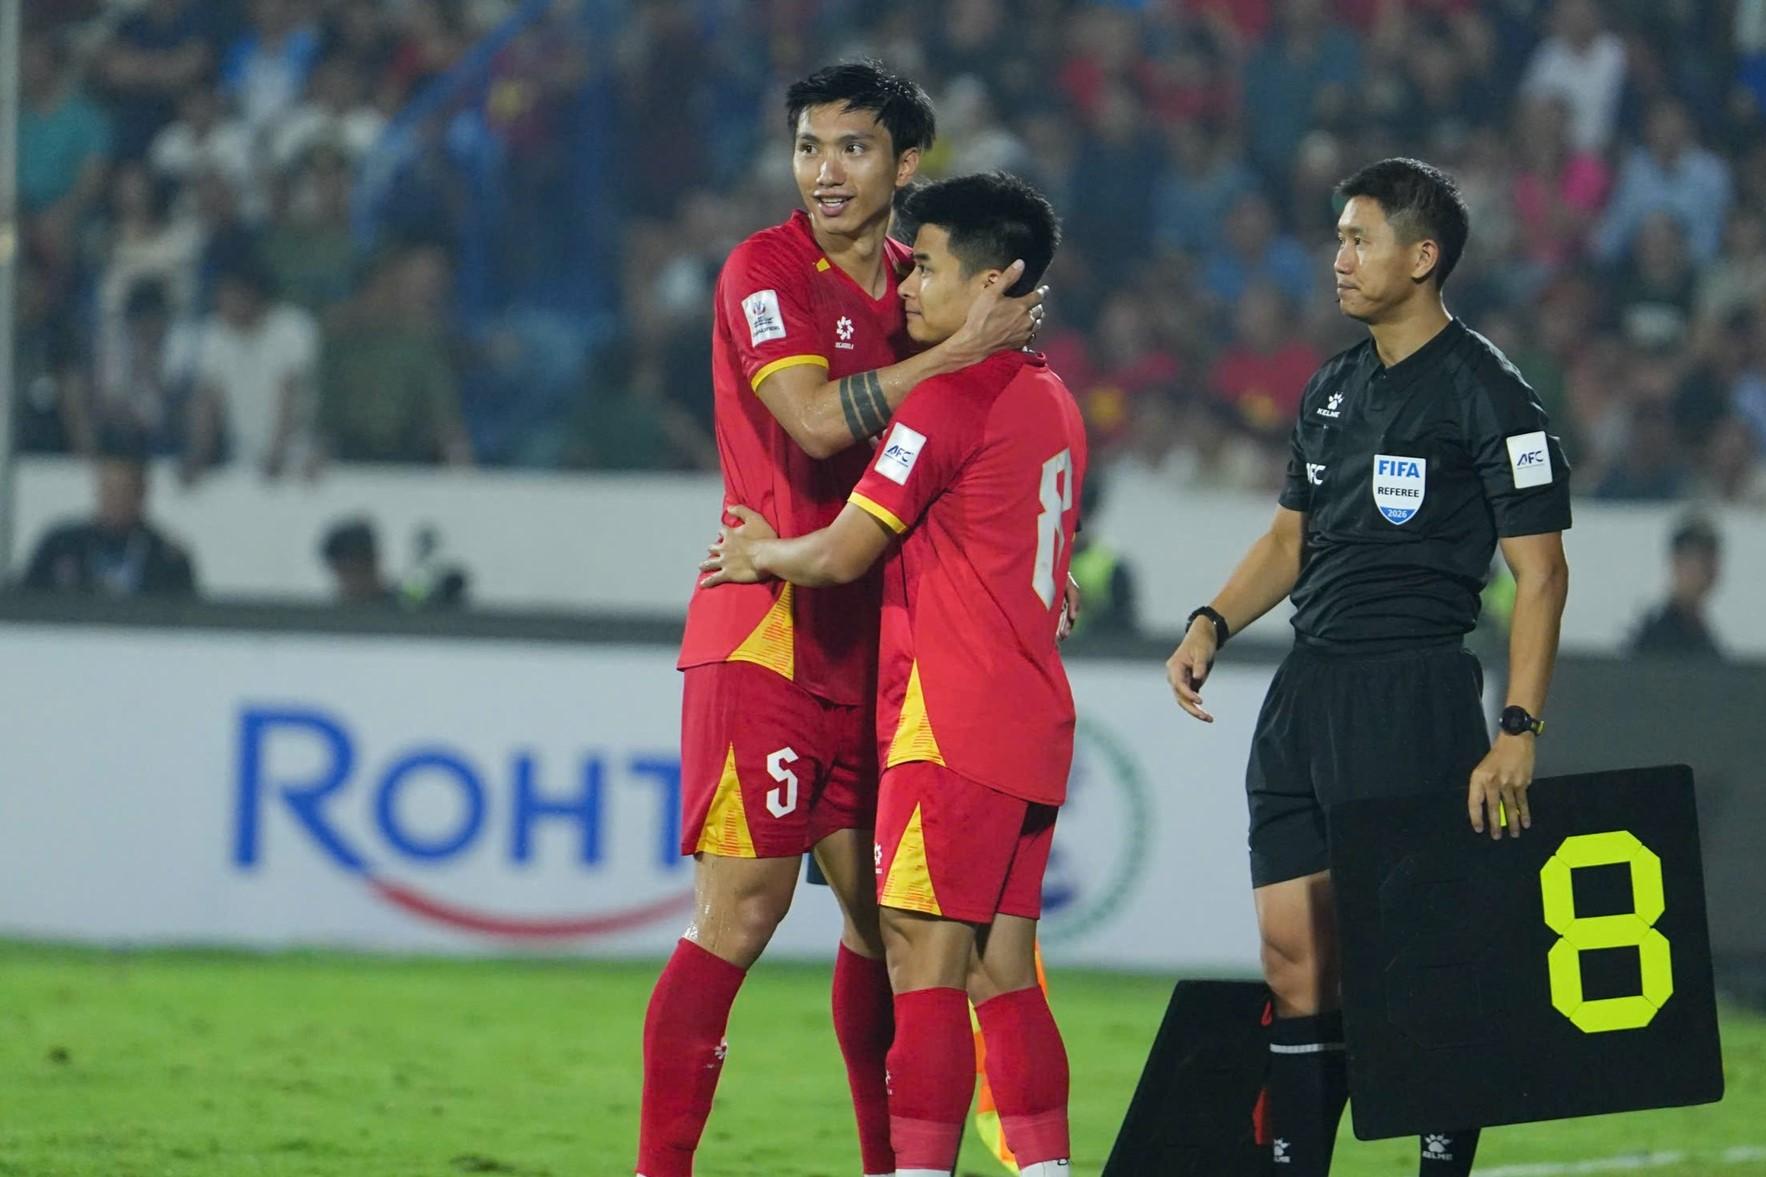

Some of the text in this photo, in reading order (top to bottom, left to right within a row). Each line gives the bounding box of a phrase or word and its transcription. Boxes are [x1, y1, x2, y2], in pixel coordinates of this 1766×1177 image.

[886, 444, 913, 463] AFC
[1516, 450, 1544, 465] AFC
[1378, 460, 1420, 478] FIFA
[1377, 486, 1420, 498] REFEREE
[1387, 508, 1408, 519] 2026
[766, 746, 799, 819] 5
[1540, 829, 1674, 1034] 8
